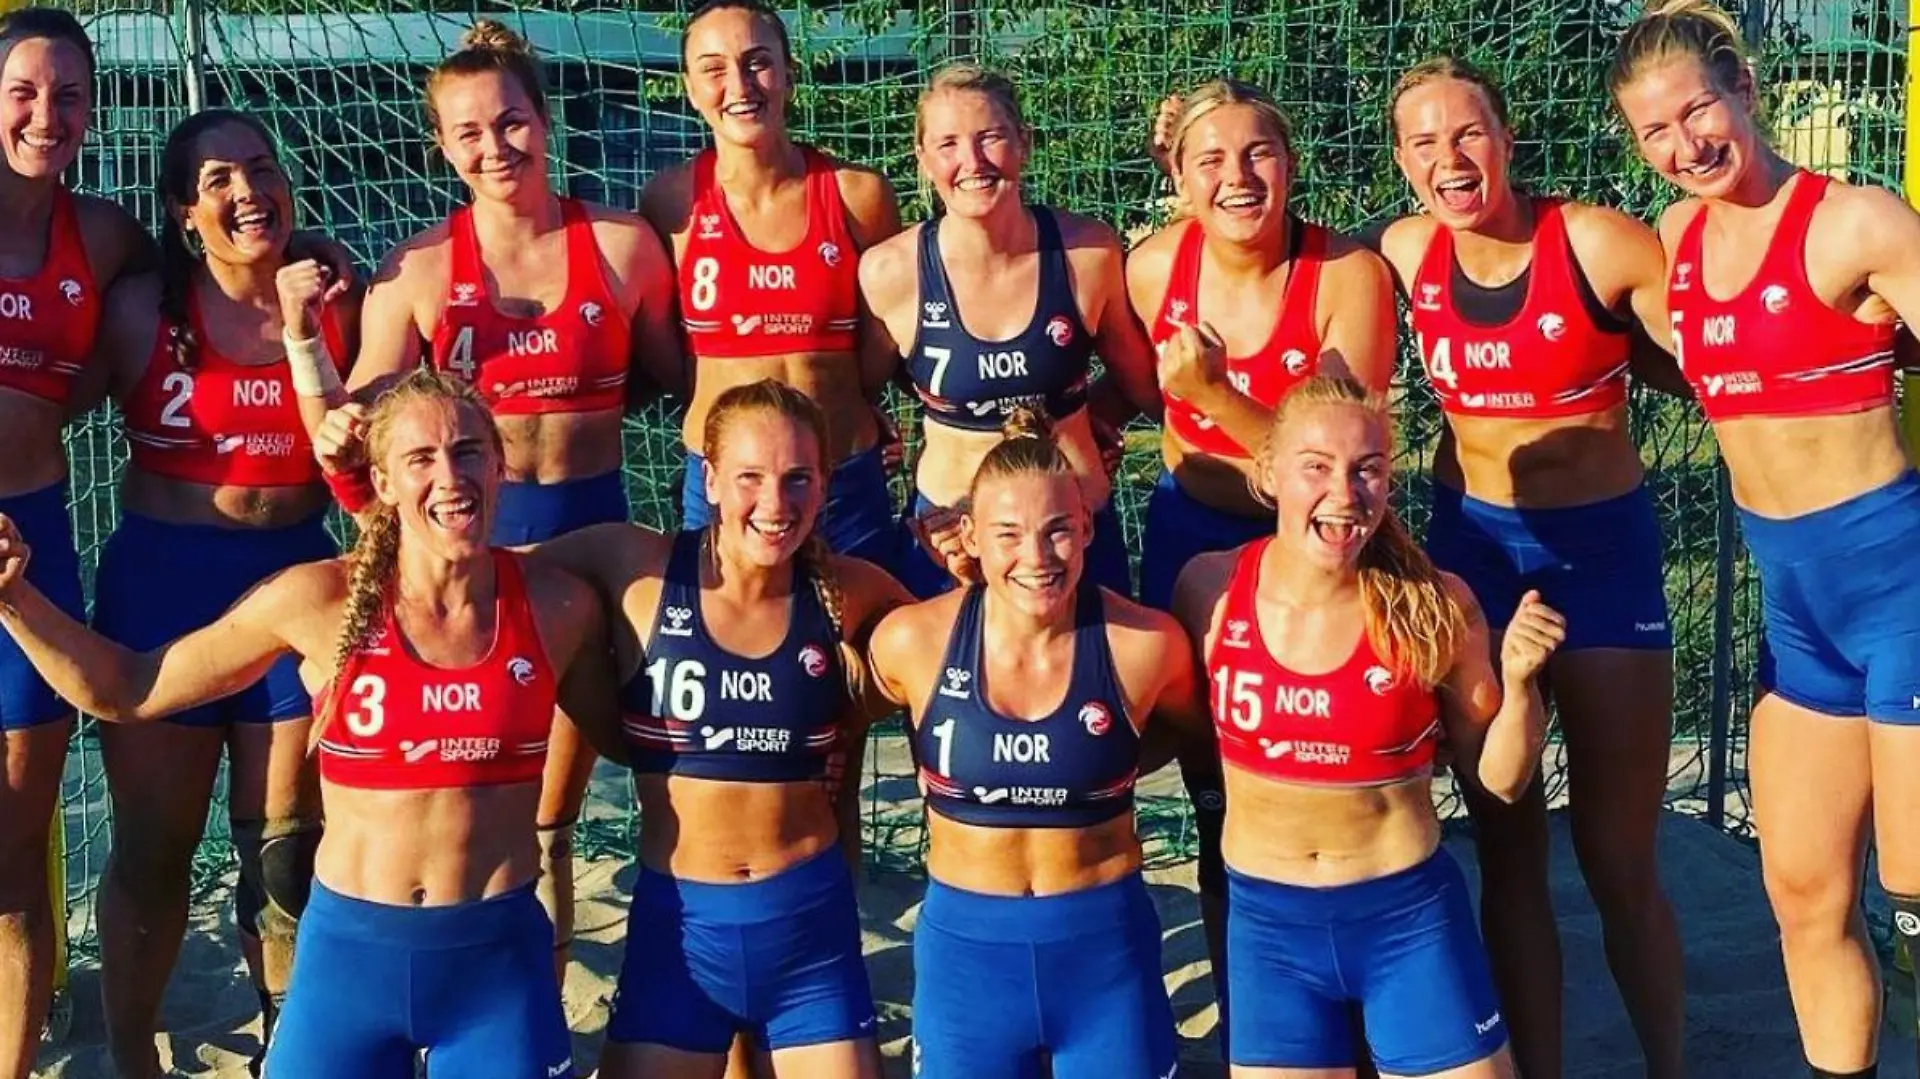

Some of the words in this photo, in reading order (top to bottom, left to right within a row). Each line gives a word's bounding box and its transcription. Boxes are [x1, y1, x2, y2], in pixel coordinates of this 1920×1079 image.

[692, 257, 719, 311] 8
[749, 265, 796, 289] NOR
[0, 292, 32, 320] OR
[764, 313, 813, 325] INTER
[508, 330, 558, 356] NOR
[764, 323, 810, 335] SPORT
[1703, 316, 1735, 346] NOR
[449, 327, 476, 379] 4
[978, 352, 1029, 380] NOR
[1464, 342, 1511, 369] NOR
[924, 346, 951, 396] 7
[161, 373, 194, 427] 2
[233, 380, 282, 406] NOR
[423, 683, 482, 712] NOR
[646, 658, 706, 721] 16
[720, 670, 773, 701] NOR
[1213, 665, 1263, 731] 15
[347, 675, 386, 736] 3
[1274, 685, 1331, 718] NOR
[440, 738, 500, 750] INTER
[736, 727, 791, 740] INTER
[736, 738, 789, 752] SPORT
[439, 749, 498, 761] SPORT
[933, 719, 955, 778] 1
[993, 734, 1050, 762] NOR
[1294, 741, 1350, 756] INTER
[1011, 787, 1068, 799] INTER
